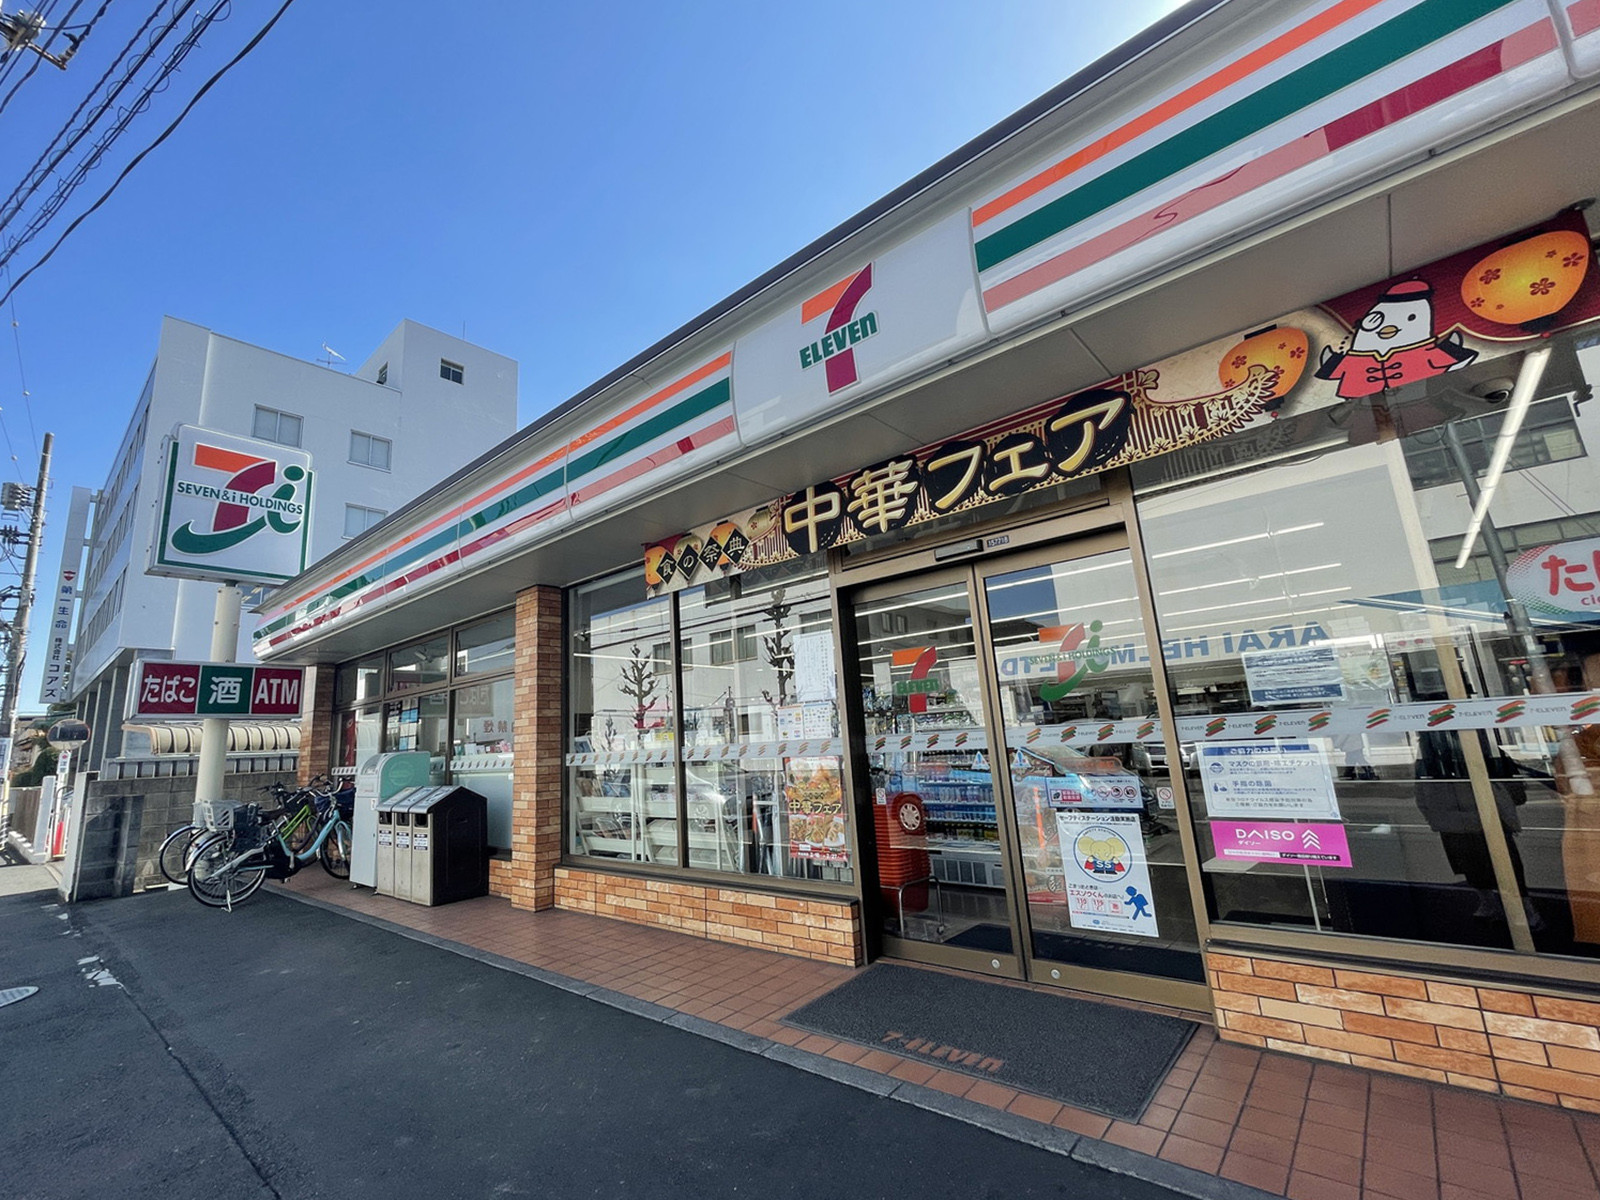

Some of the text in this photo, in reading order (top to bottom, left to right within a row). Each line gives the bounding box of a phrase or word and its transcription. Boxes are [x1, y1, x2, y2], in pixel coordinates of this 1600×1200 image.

[783, 397, 1126, 554] 中華フェア
[239, 493, 304, 515] HOLDINGS
[660, 536, 745, 577] 食の祭典
[55, 585, 73, 629] 第一生命
[1066, 646, 1118, 660] HOLDINGS
[44, 664, 60, 698] コアズ
[141, 674, 196, 704] たばこ
[208, 676, 243, 705] 酒
[254, 677, 299, 705] ATM
[788, 798, 842, 814] 中華フェア
[1235, 828, 1295, 841] DAISO
